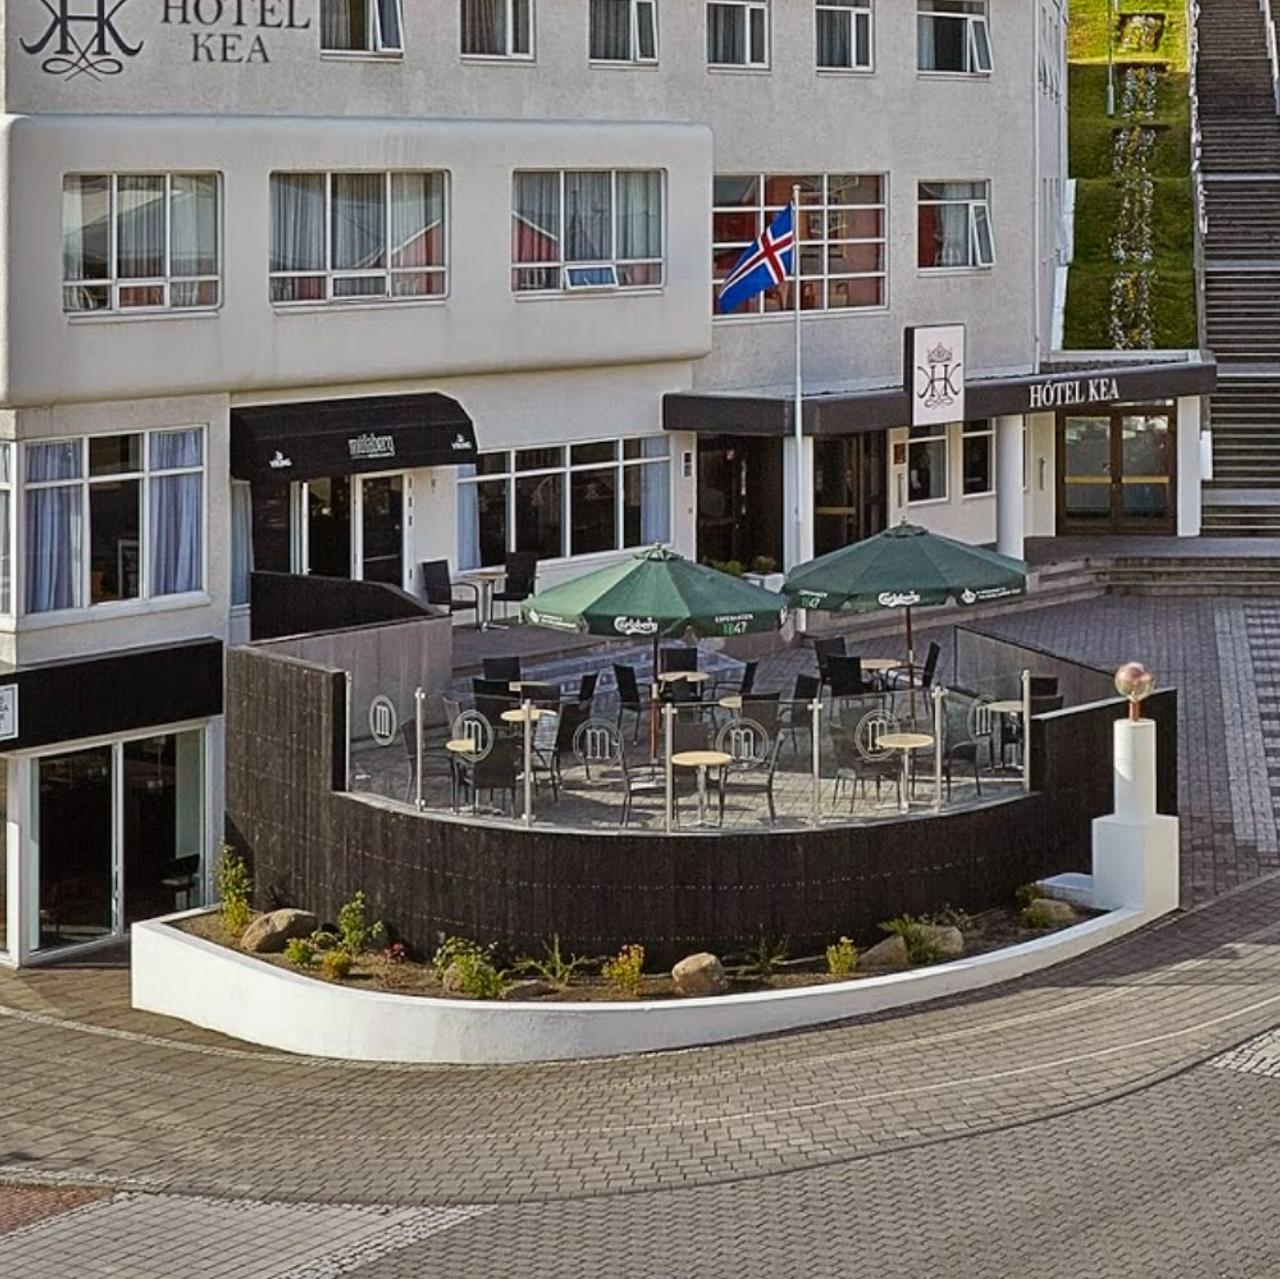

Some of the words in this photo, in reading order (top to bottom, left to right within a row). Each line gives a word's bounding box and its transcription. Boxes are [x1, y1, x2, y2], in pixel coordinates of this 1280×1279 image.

[192, 33, 271, 64] KEA
[1029, 379, 1086, 407] HÓTEL
[1089, 377, 1120, 403] KEA
[614, 616, 658, 635] Carlsberg
